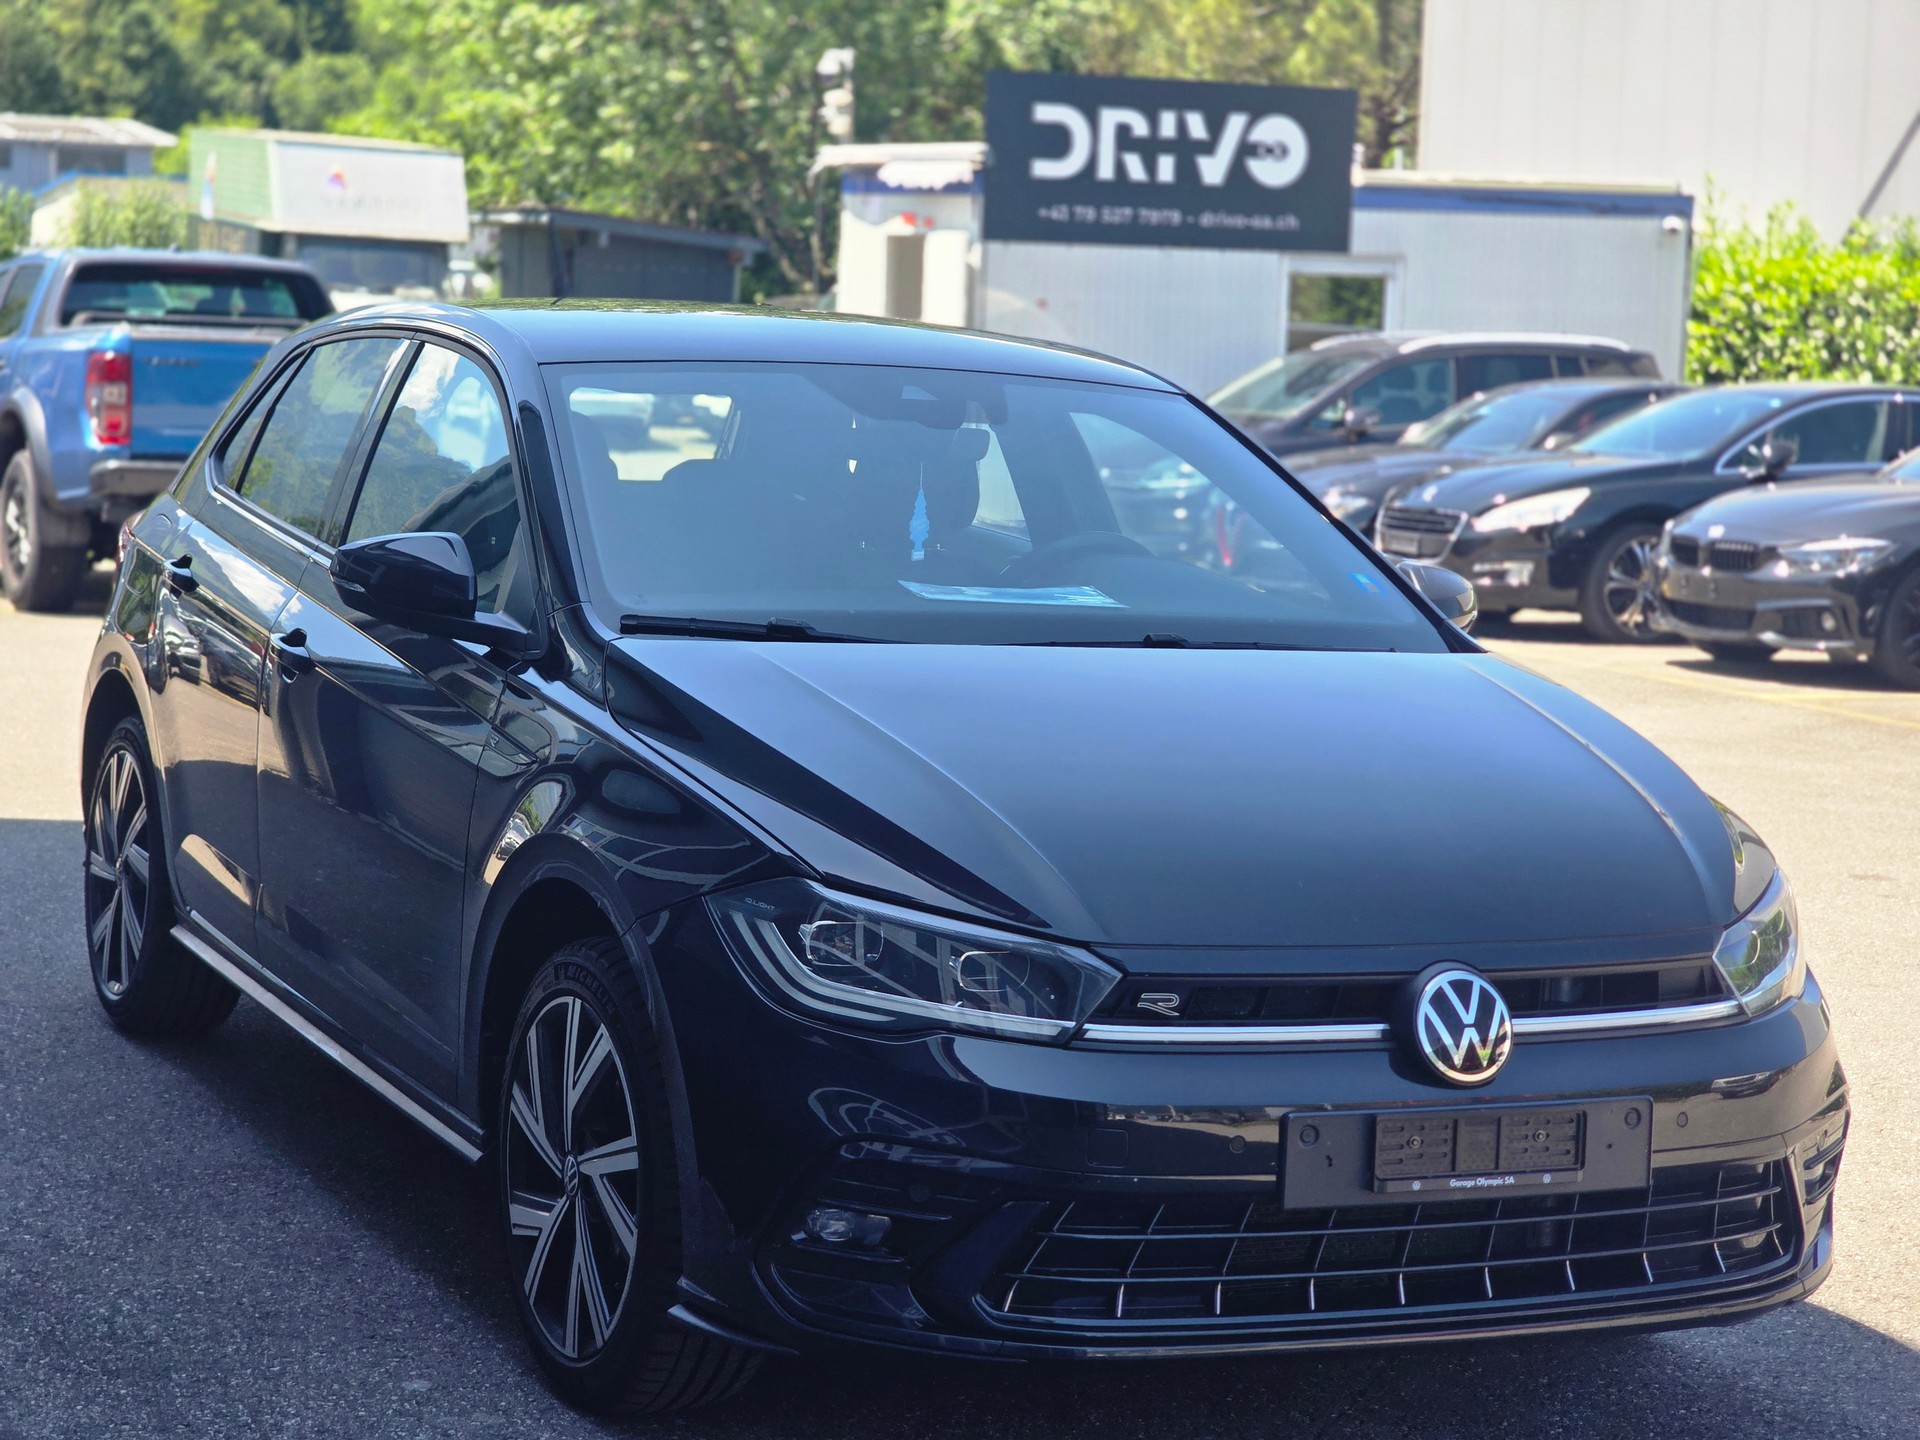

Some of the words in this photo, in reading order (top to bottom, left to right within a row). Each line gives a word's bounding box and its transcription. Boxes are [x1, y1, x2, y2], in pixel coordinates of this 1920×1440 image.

[1029, 101, 1309, 189] DRIVO
[566, 965, 617, 1015] MICHELIN
[1450, 1178, 1475, 1189] Garage
[1476, 1176, 1504, 1188] Olympic
[1505, 1175, 1515, 1185] SA
